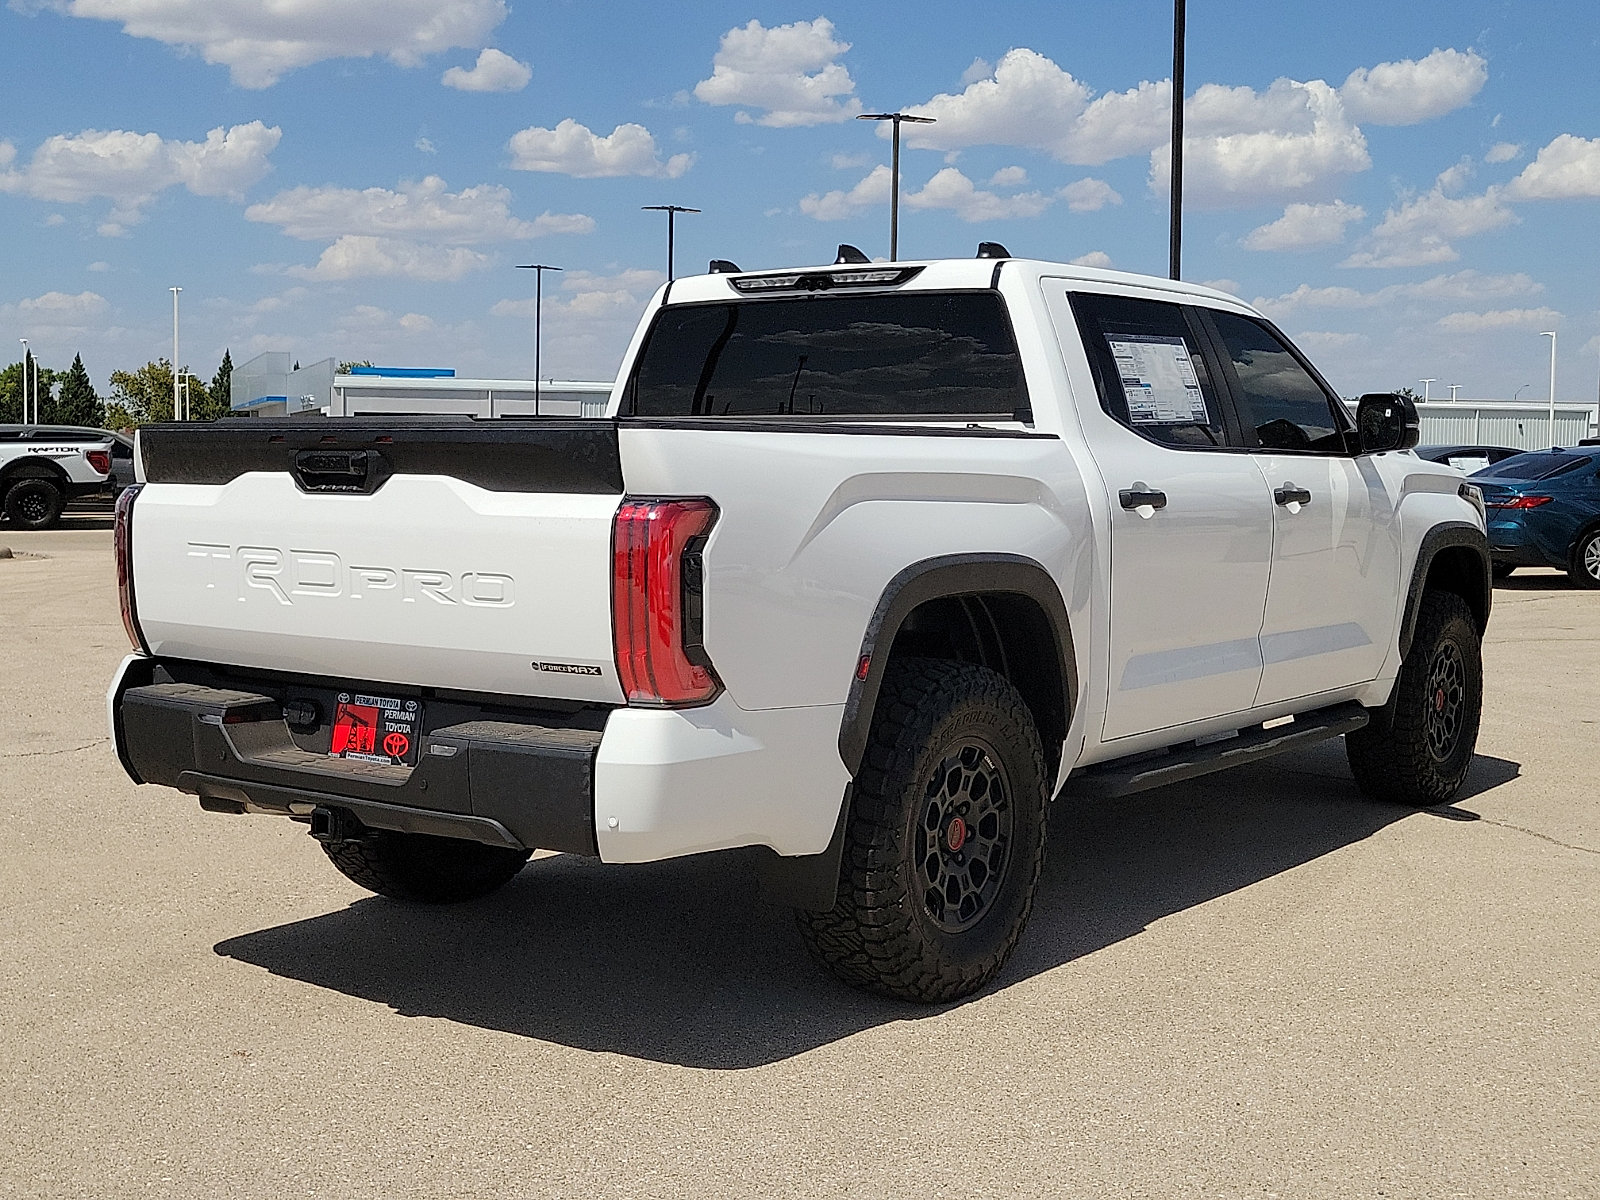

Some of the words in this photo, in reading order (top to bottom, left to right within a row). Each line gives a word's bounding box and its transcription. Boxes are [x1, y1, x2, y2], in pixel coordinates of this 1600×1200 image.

[187, 541, 294, 606] TRD
[349, 565, 516, 609] PRO
[356, 697, 378, 706] PERMIAN
[379, 699, 400, 709] TOYOTA
[384, 710, 415, 721] PERMIAN
[385, 722, 411, 733] TOYOTA
